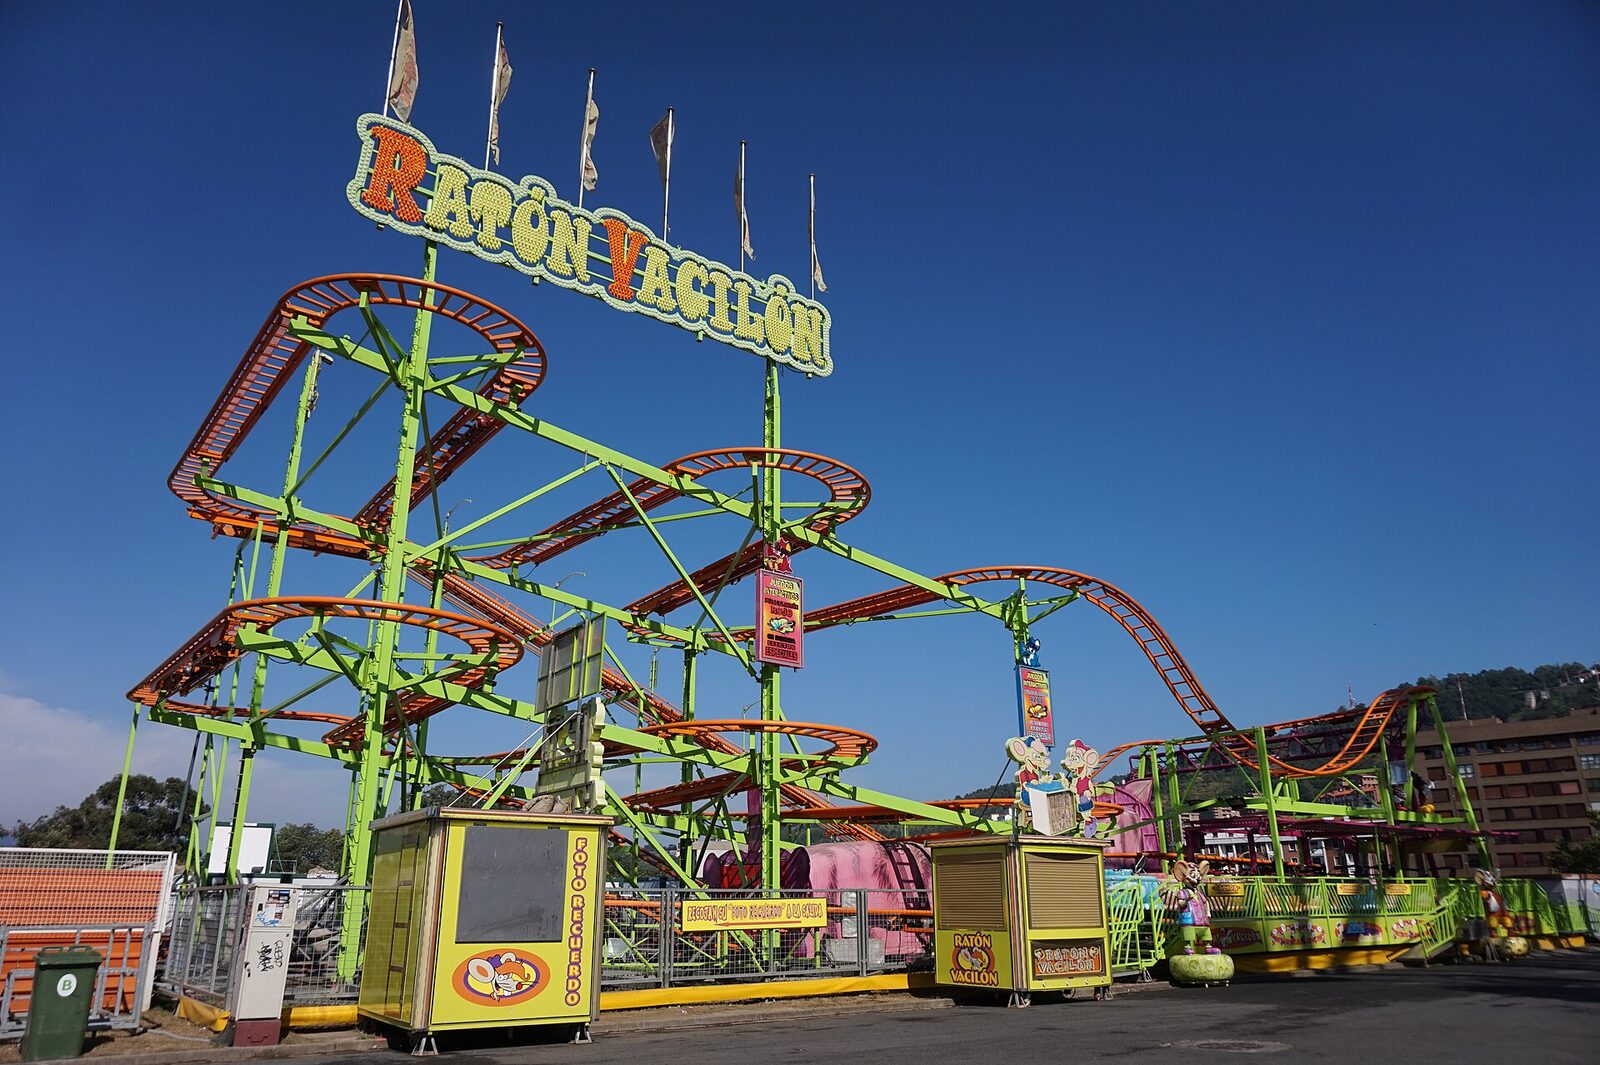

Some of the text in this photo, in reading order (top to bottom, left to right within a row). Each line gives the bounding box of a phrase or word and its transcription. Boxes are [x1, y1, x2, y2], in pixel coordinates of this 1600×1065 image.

[565, 837, 588, 1006] FOTO RECUERDO
[954, 931, 992, 948] RATÓN
[62, 979, 73, 991] B
[949, 967, 999, 986] VACILÓN
